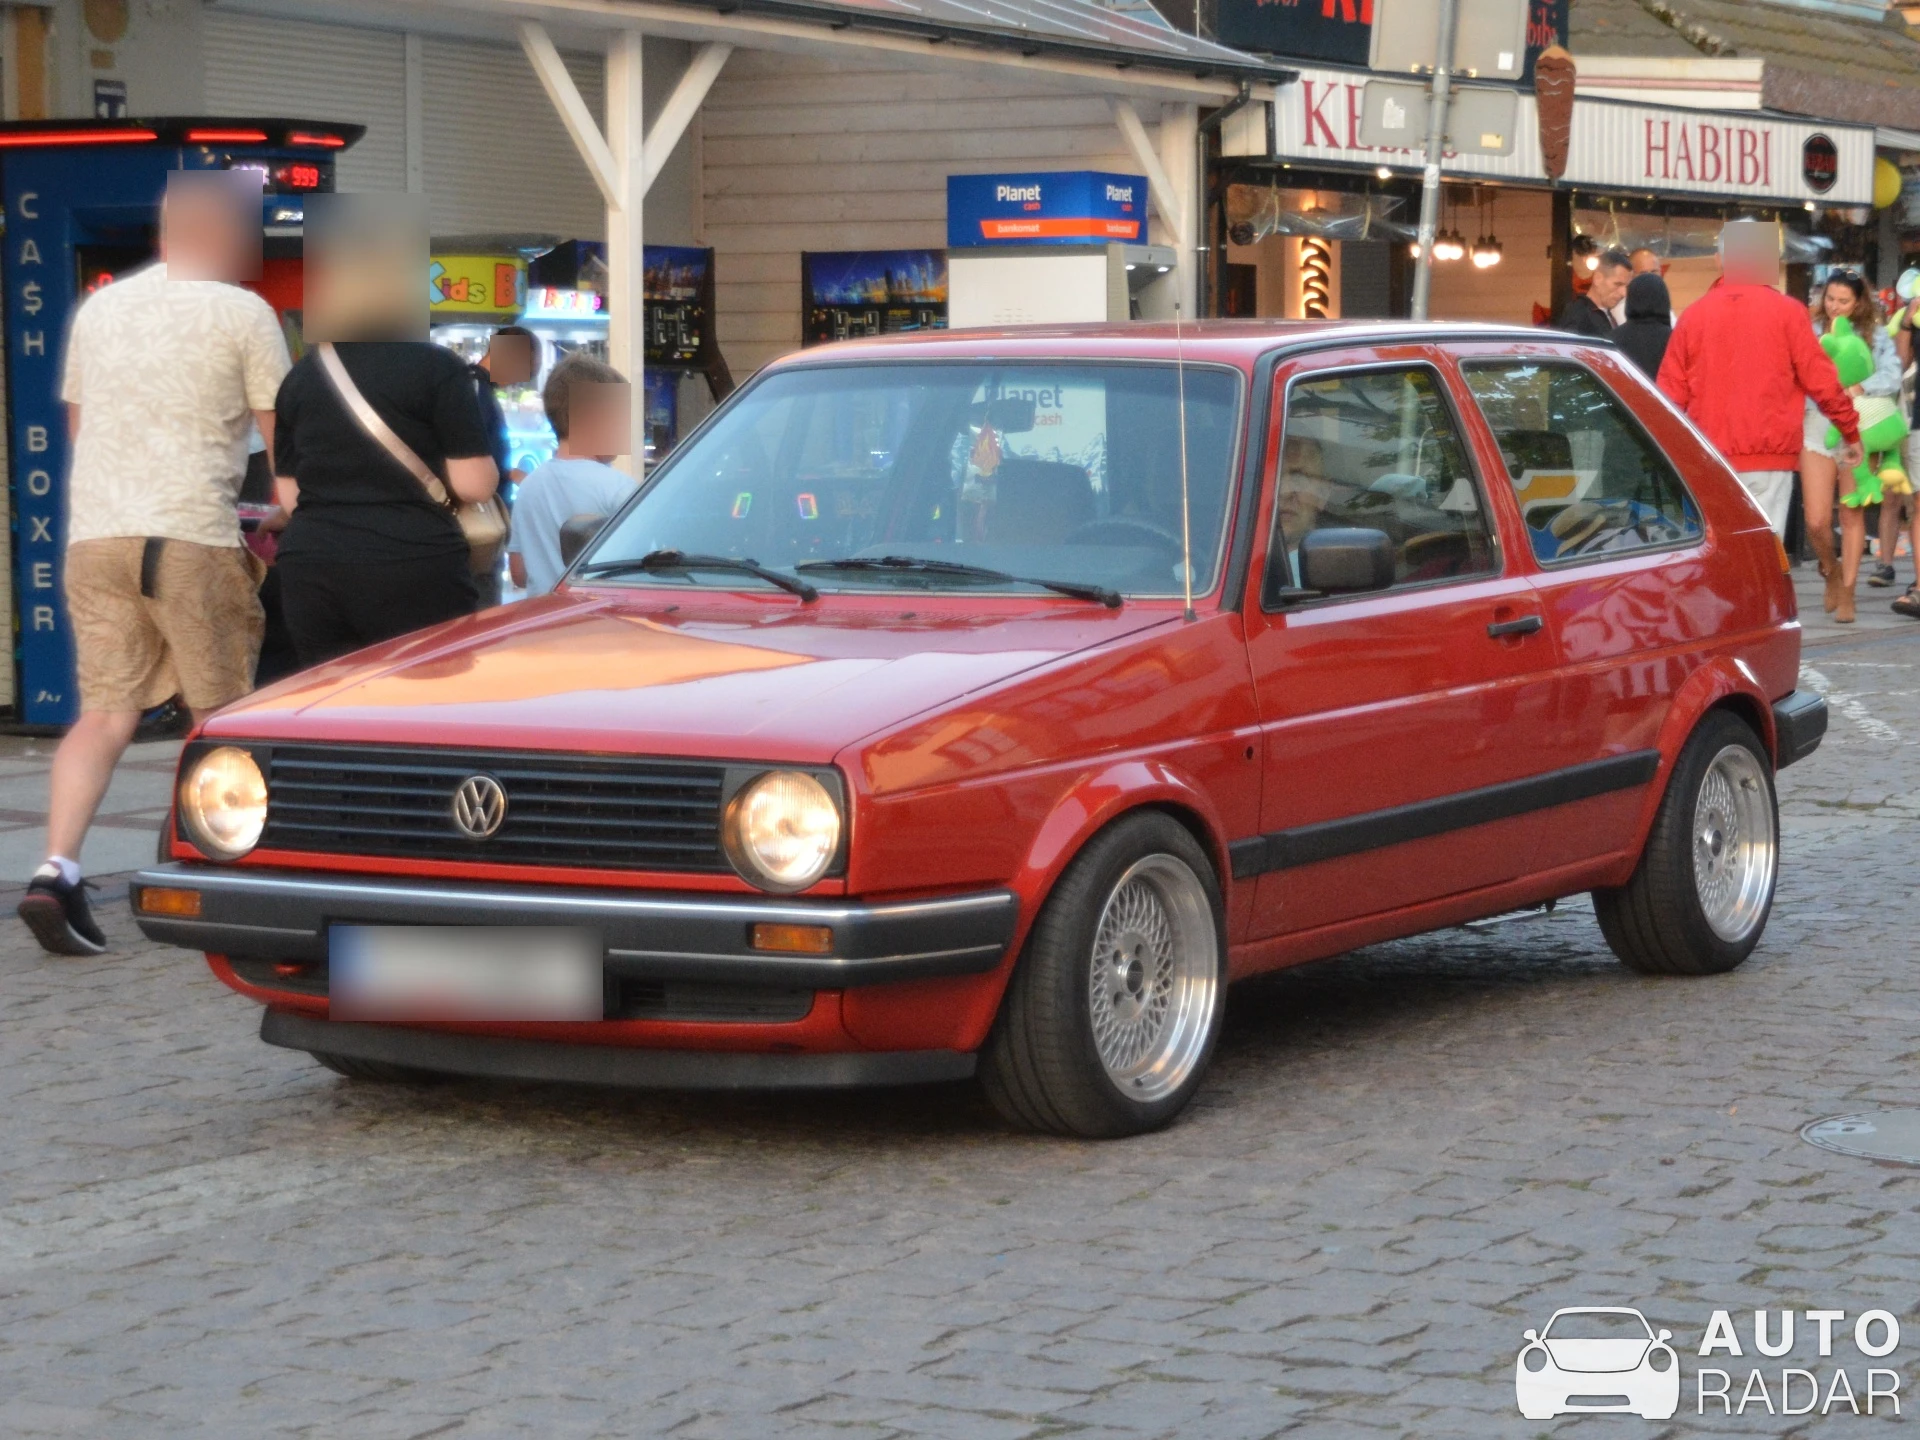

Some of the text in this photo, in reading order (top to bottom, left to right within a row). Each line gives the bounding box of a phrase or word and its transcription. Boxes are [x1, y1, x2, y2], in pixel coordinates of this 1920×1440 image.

[1644, 118, 1770, 187] HABIBI
[997, 185, 1041, 201] Planet
[1106, 185, 1132, 202] Planet
[997, 223, 1040, 233] bankomat
[27, 426, 54, 631] BOXER
